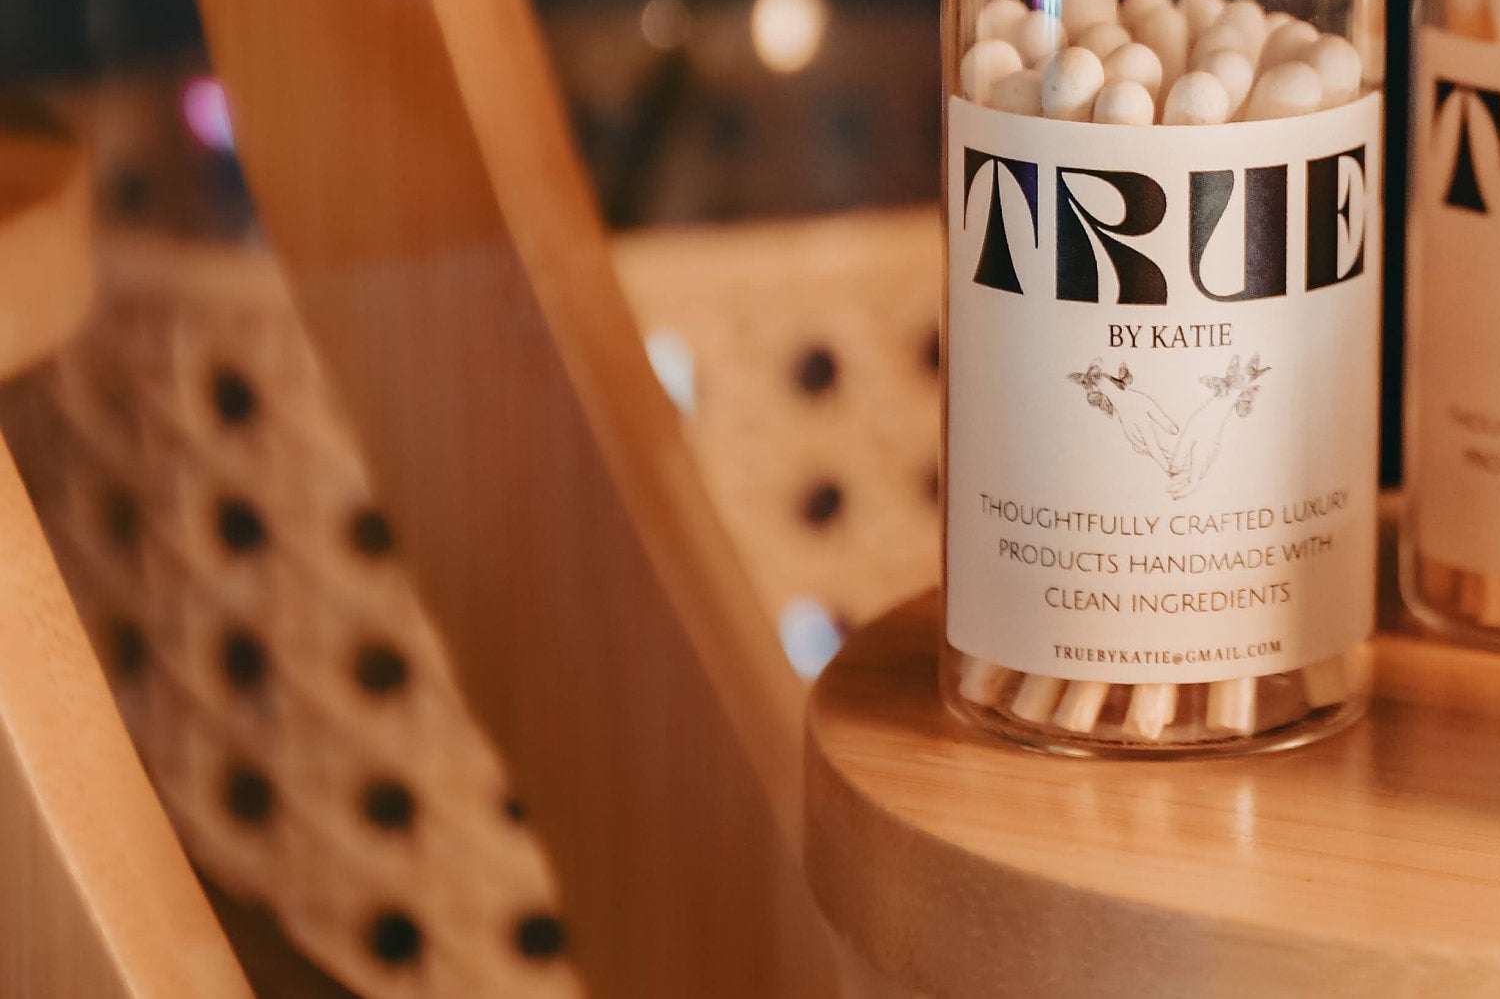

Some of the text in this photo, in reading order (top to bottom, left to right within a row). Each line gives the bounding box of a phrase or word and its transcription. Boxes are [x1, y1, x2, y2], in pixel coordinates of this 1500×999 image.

[964, 144, 1366, 305] TRUE
[1108, 323, 1232, 348] BY KATIE
[980, 490, 1348, 535] THOUGHTFULLY CRAFTED LUXURY
[999, 535, 1331, 573] PRODUCTS HANDMADE WITH
[1044, 582, 1291, 613] CLEAN INGREDIENTS
